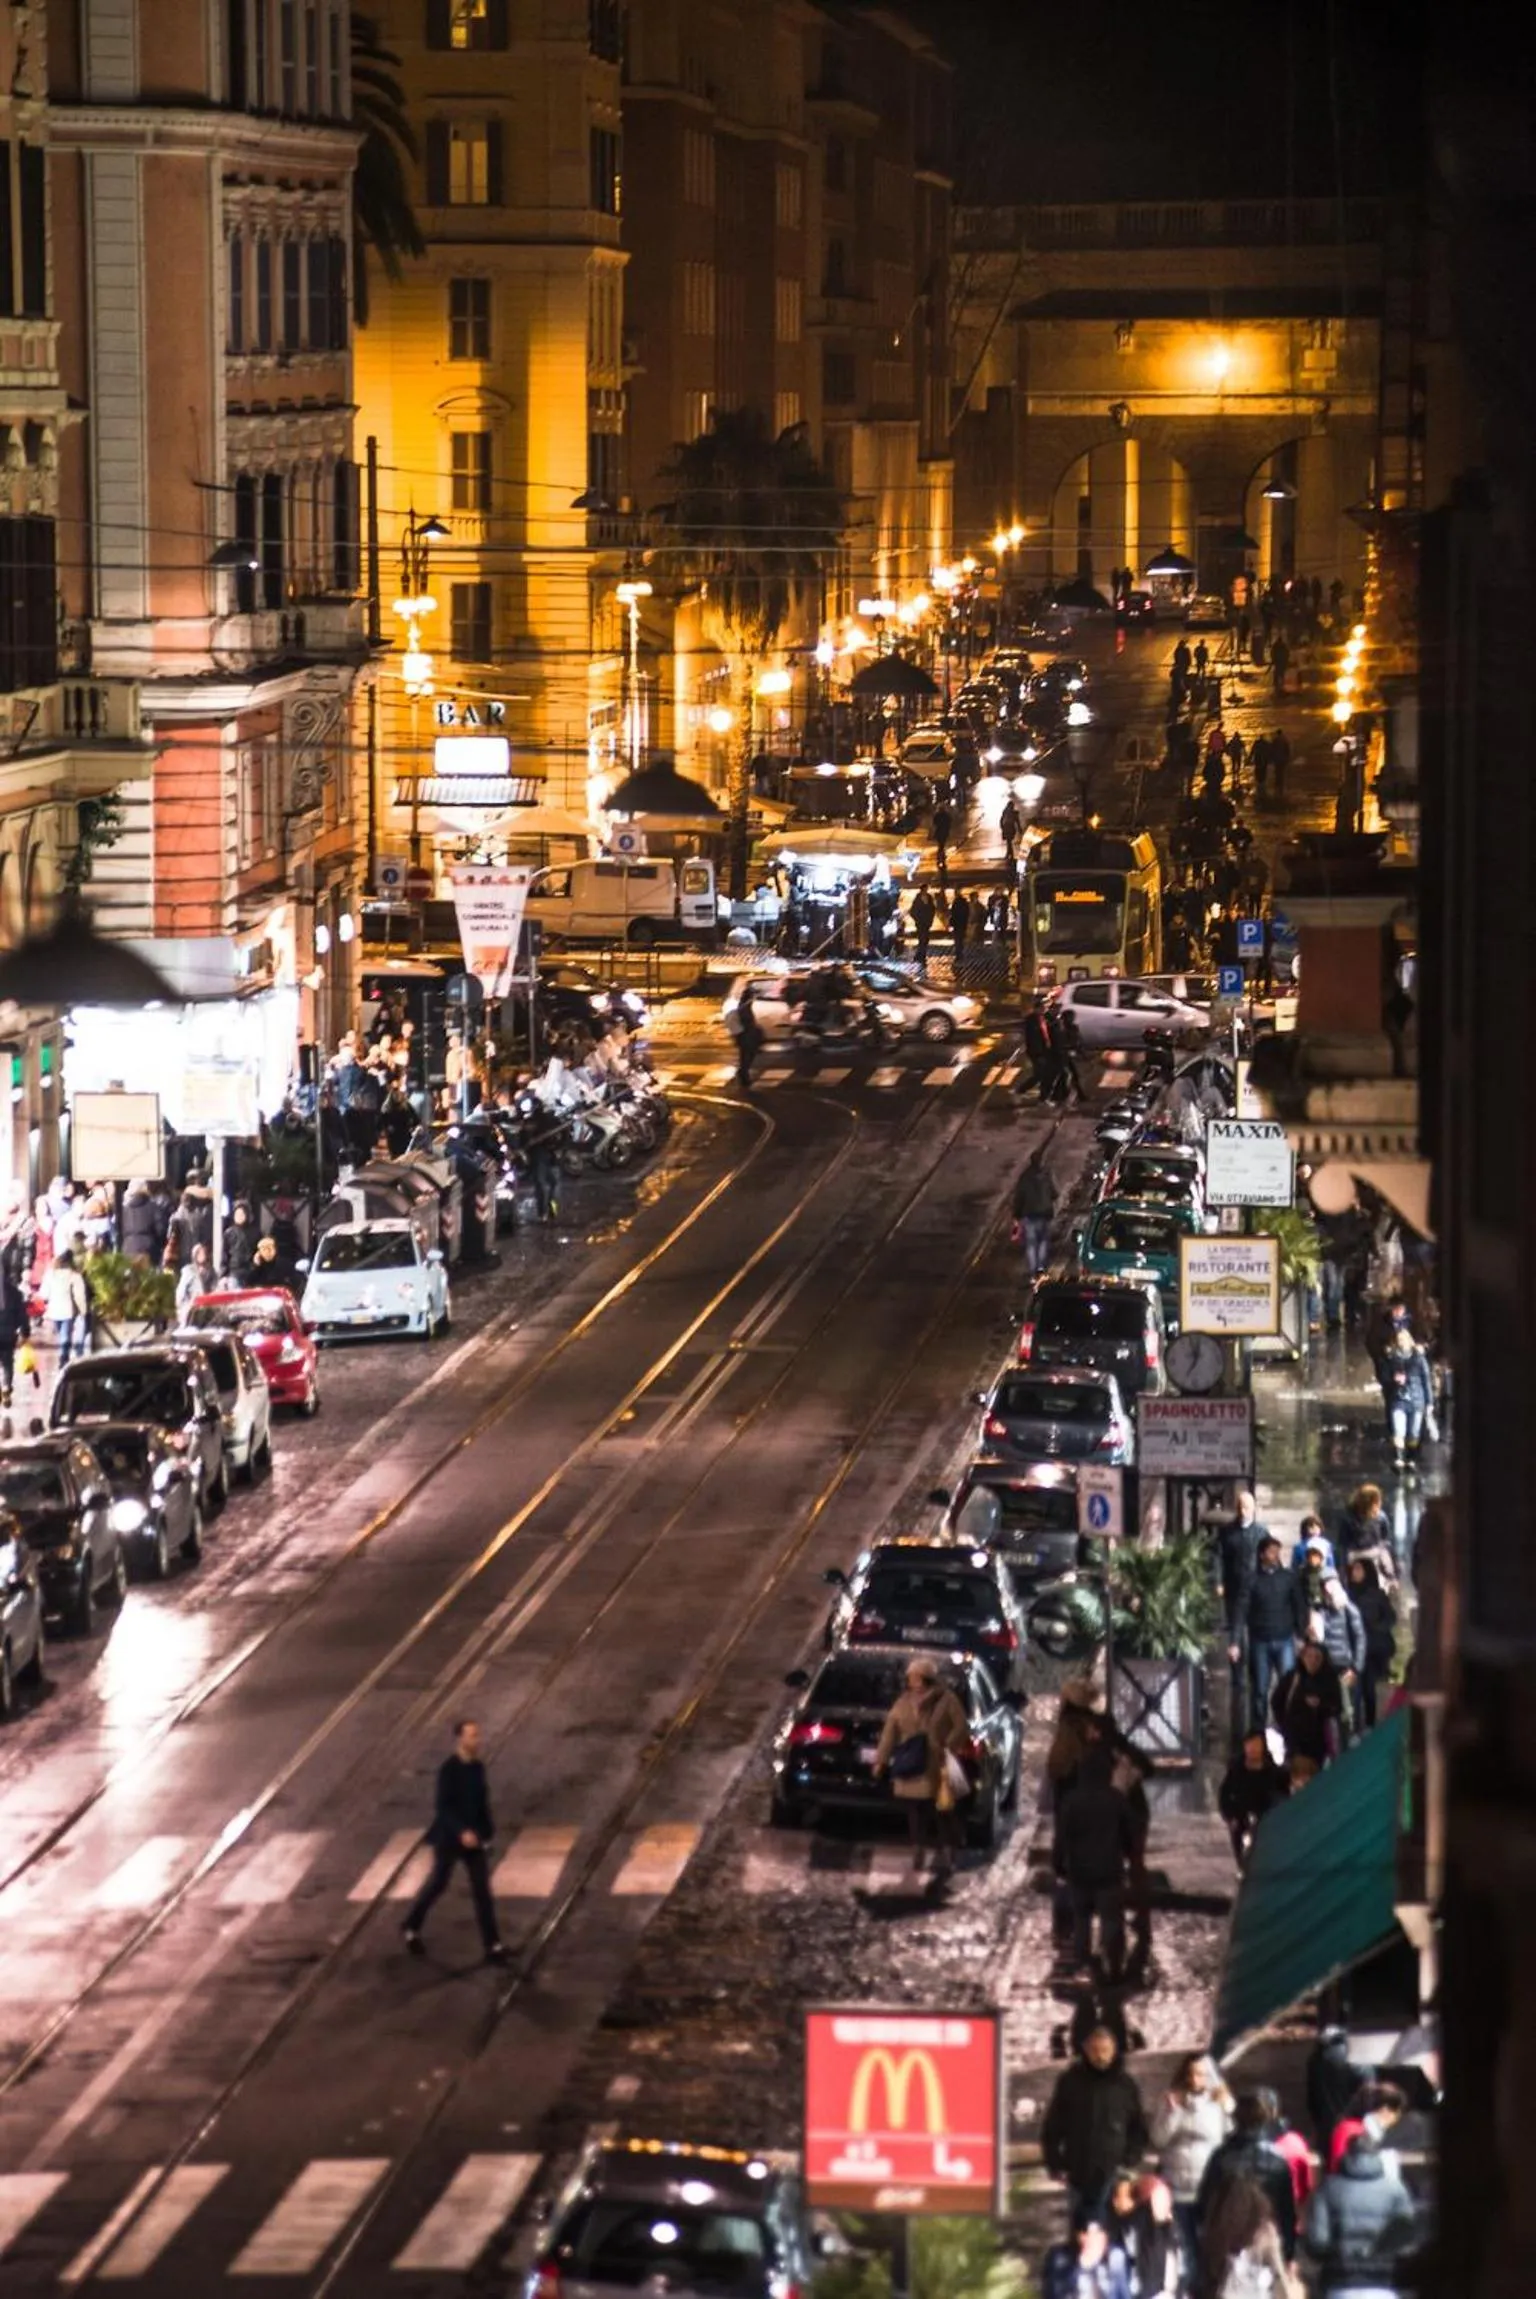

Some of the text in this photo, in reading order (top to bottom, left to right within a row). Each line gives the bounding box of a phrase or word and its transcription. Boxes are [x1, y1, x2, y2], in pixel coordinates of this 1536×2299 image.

[436, 702, 506, 725] BAR
[1243, 923, 1258, 942] P
[1223, 970, 1238, 990] P
[1209, 1191, 1224, 1202] VIA
[1188, 1261, 1271, 1273] RISTORANTE
[1144, 1402, 1246, 1419] SPAGNOLETTO
